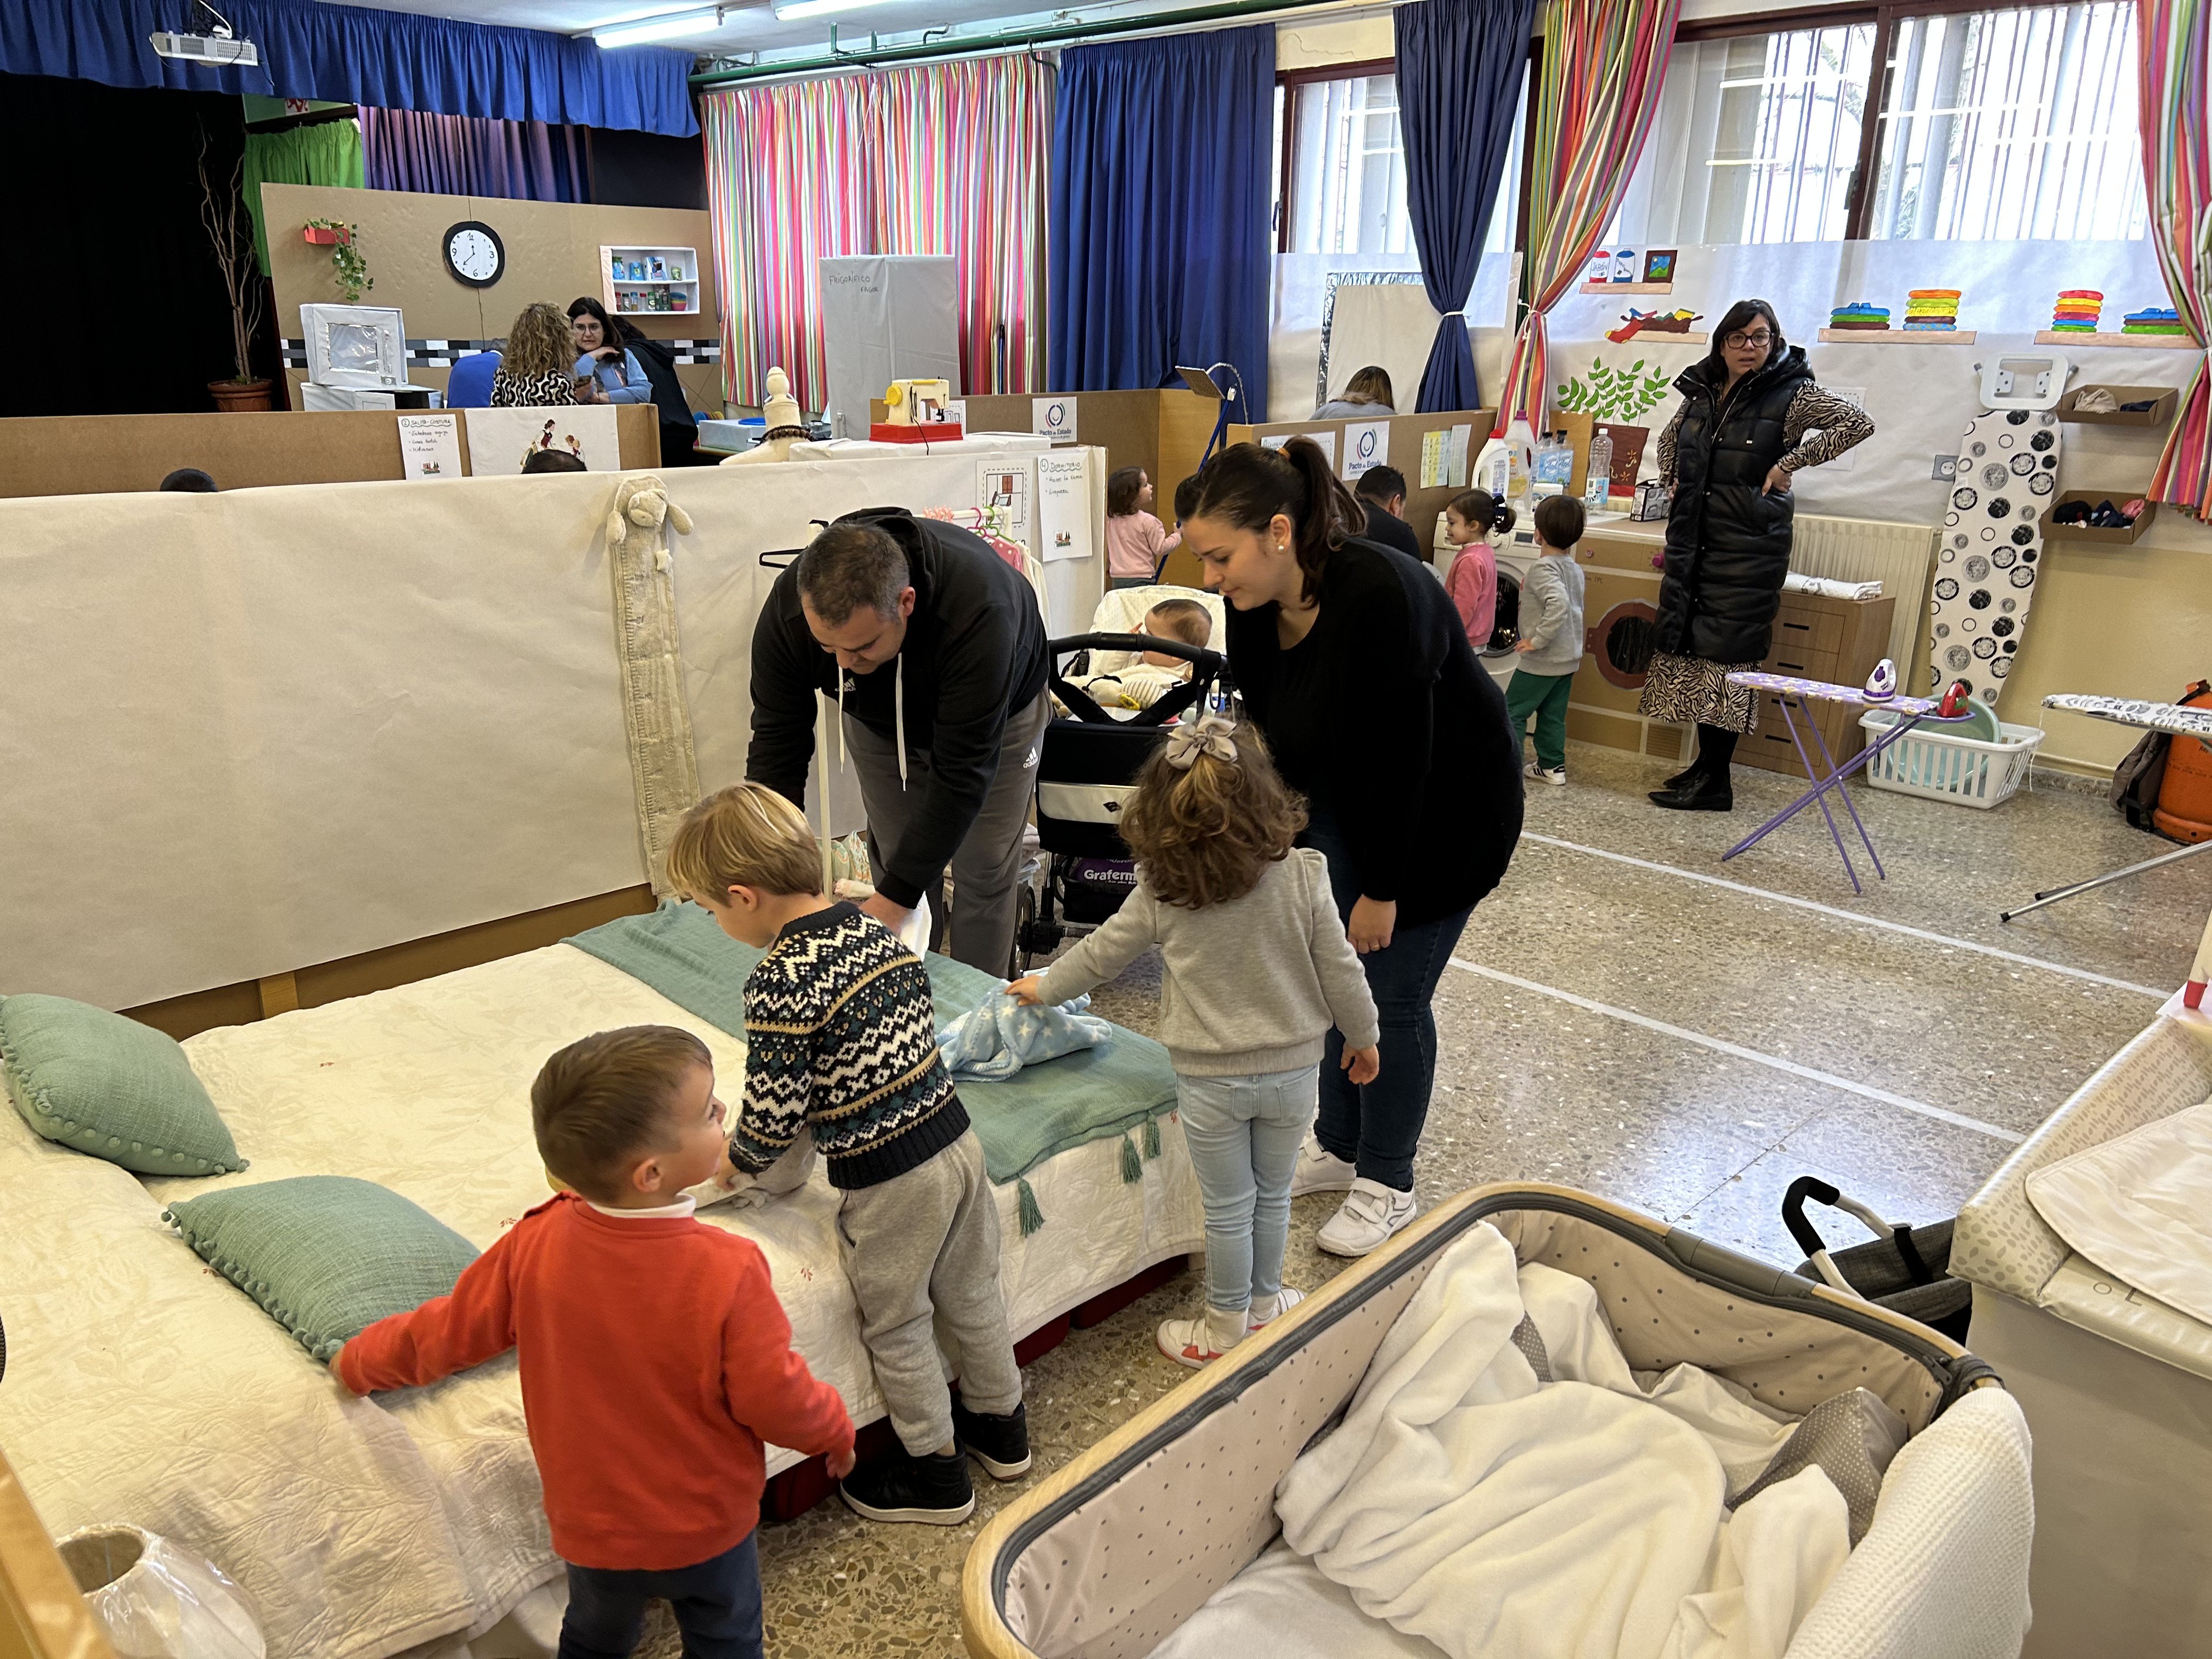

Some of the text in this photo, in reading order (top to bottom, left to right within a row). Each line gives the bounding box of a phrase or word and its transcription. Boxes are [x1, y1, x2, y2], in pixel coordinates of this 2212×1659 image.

[467, 232, 474, 240] 12
[452, 248, 457, 256] 9
[473, 269, 478, 277] 6
[1367, 459, 1381, 467] Estado
